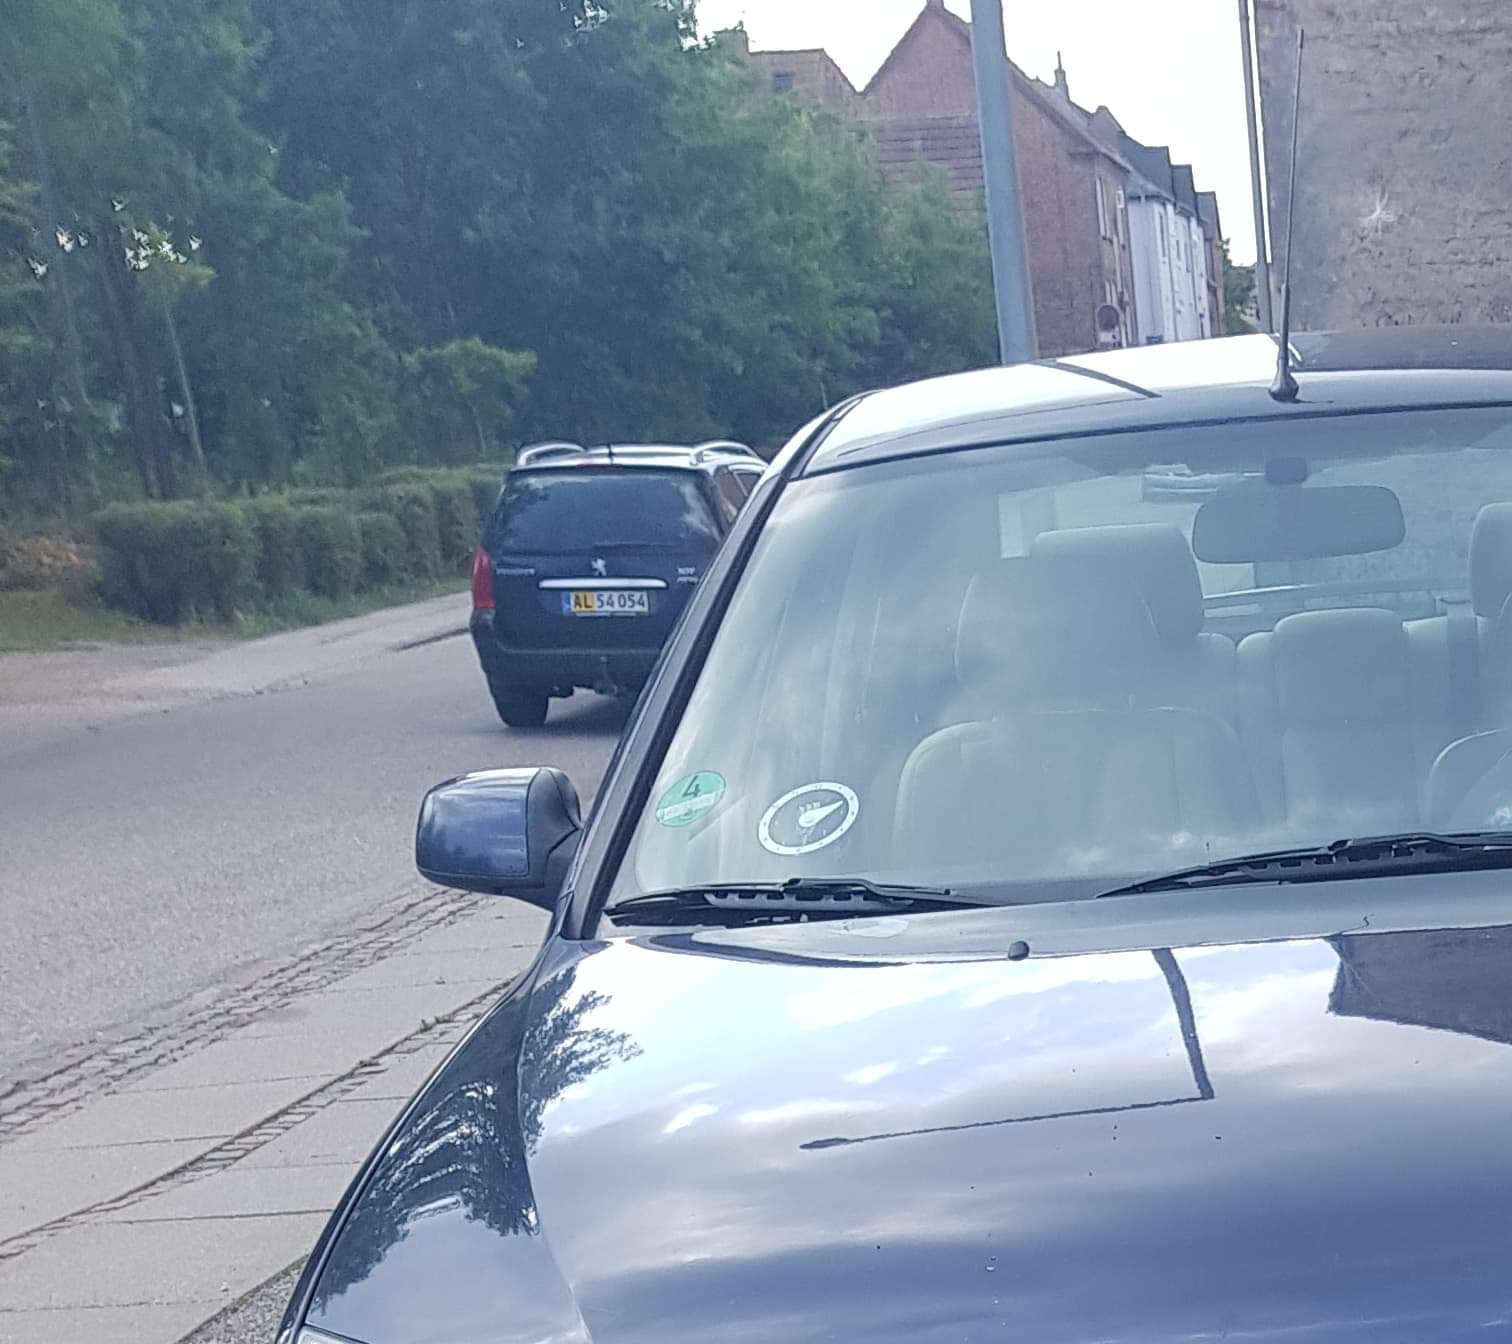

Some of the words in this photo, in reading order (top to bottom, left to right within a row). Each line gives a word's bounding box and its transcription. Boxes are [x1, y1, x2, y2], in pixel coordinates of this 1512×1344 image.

[574, 594, 593, 609] AL
[597, 593, 614, 608] 54
[618, 593, 645, 609] 054
[682, 775, 700, 798] 4
